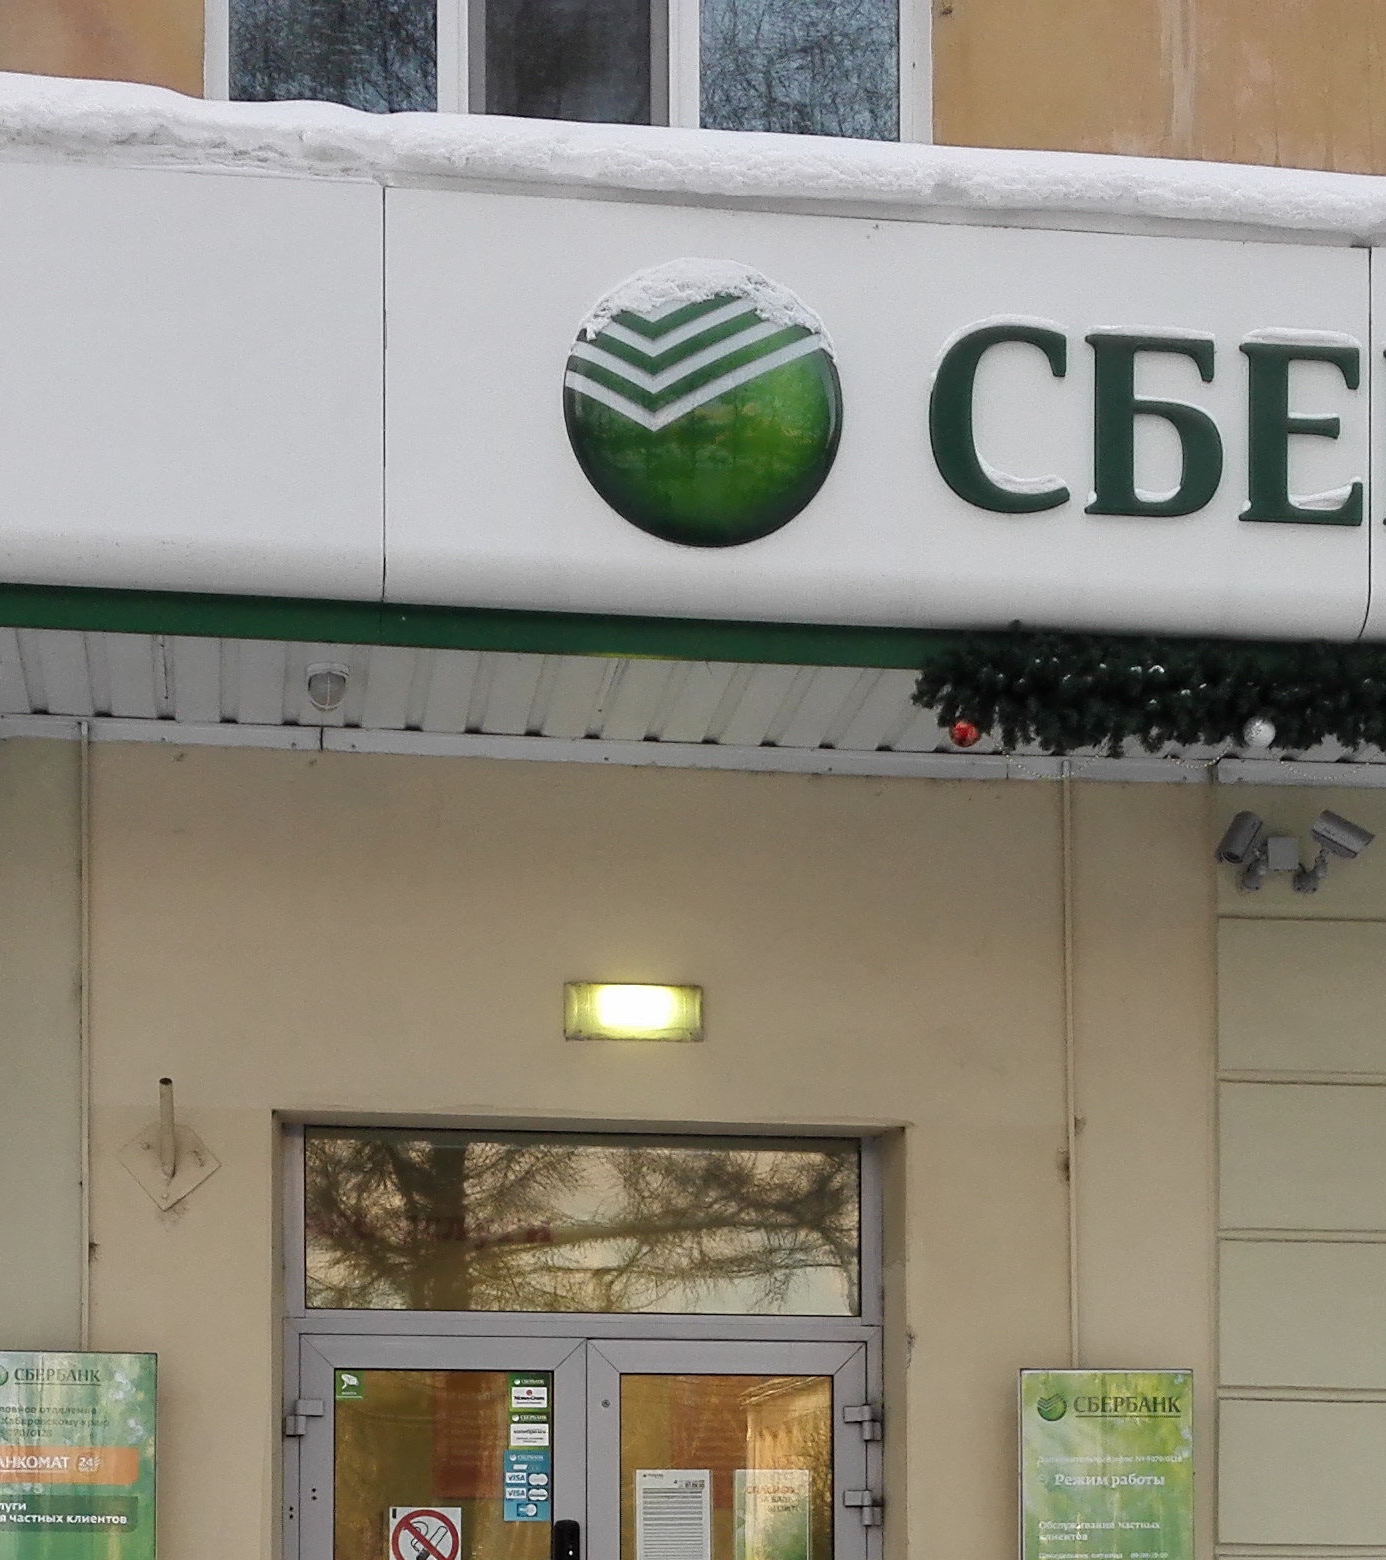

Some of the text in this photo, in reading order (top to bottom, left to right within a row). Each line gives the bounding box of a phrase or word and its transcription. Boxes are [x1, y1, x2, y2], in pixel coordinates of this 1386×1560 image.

[13, 1368, 102, 1383] СБЕРБАНК
[1073, 1396, 1182, 1414] СБЕРБАНК
[1054, 1474, 1165, 1488] Режим работы
[9, 1514, 64, 1525] частных
[66, 1514, 129, 1526] клиентов
[1118, 1522, 1162, 1530] частных
